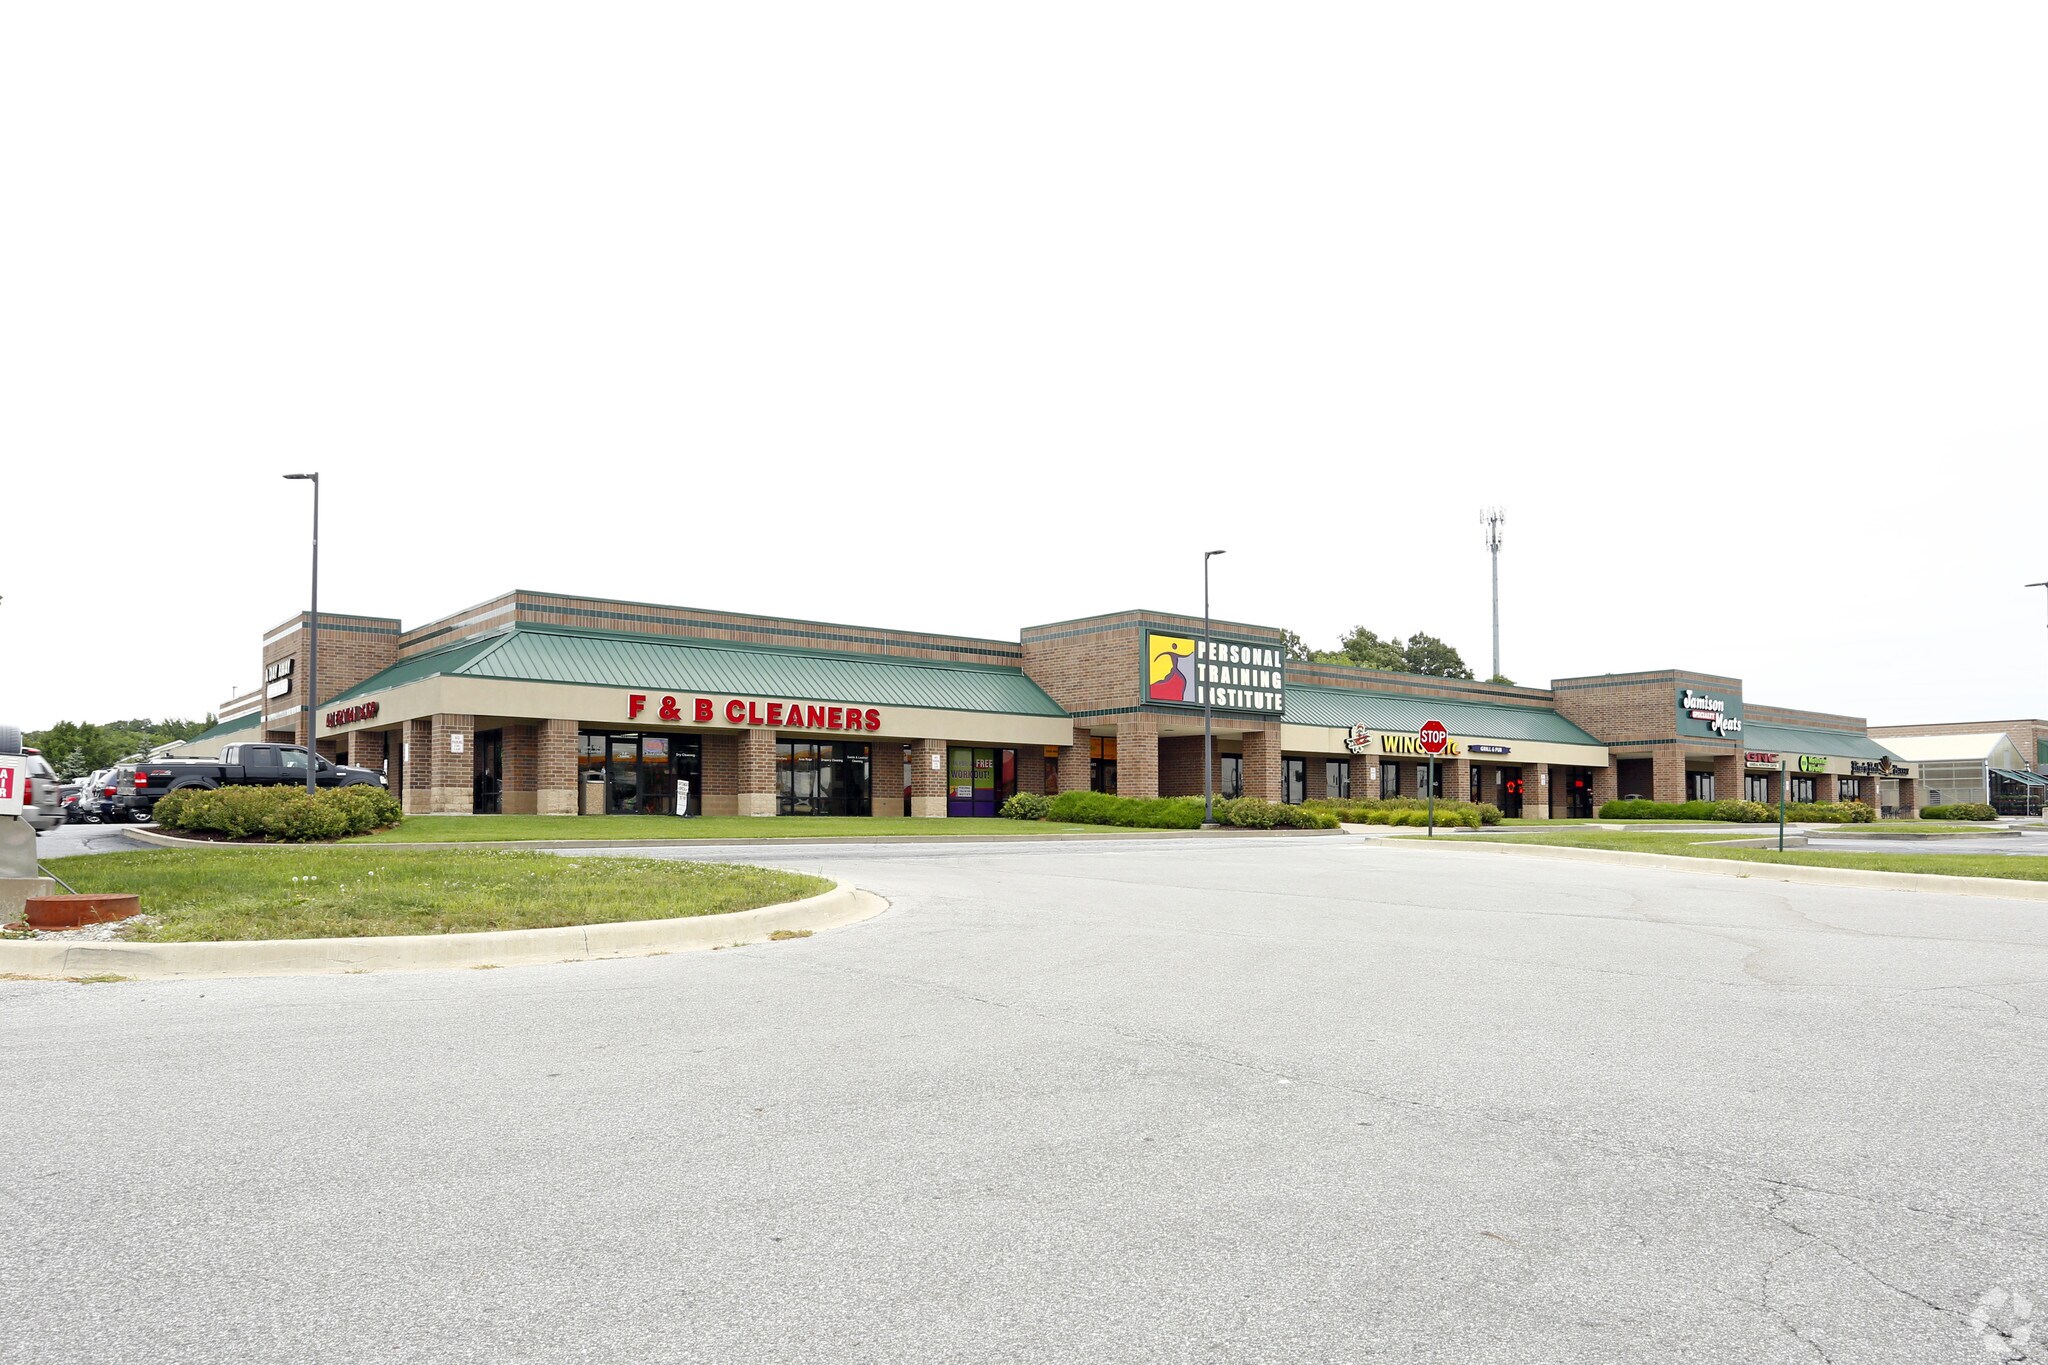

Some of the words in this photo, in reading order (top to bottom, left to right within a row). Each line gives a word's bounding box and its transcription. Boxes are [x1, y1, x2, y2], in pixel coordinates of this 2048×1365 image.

[1197, 640, 1281, 668] PERSONAL
[1197, 663, 1282, 690] TRAINING
[1197, 685, 1283, 711] INSTITUTE
[1683, 690, 1724, 711] Jamison
[627, 693, 647, 719] F
[657, 695, 682, 722] &
[693, 698, 714, 723] B
[723, 699, 881, 731] CLEANERS
[1711, 713, 1742, 736] Meats
[1421, 730, 1446, 743] STOP
[976, 759, 993, 768] FREE
[1747, 752, 1779, 763] GNC
